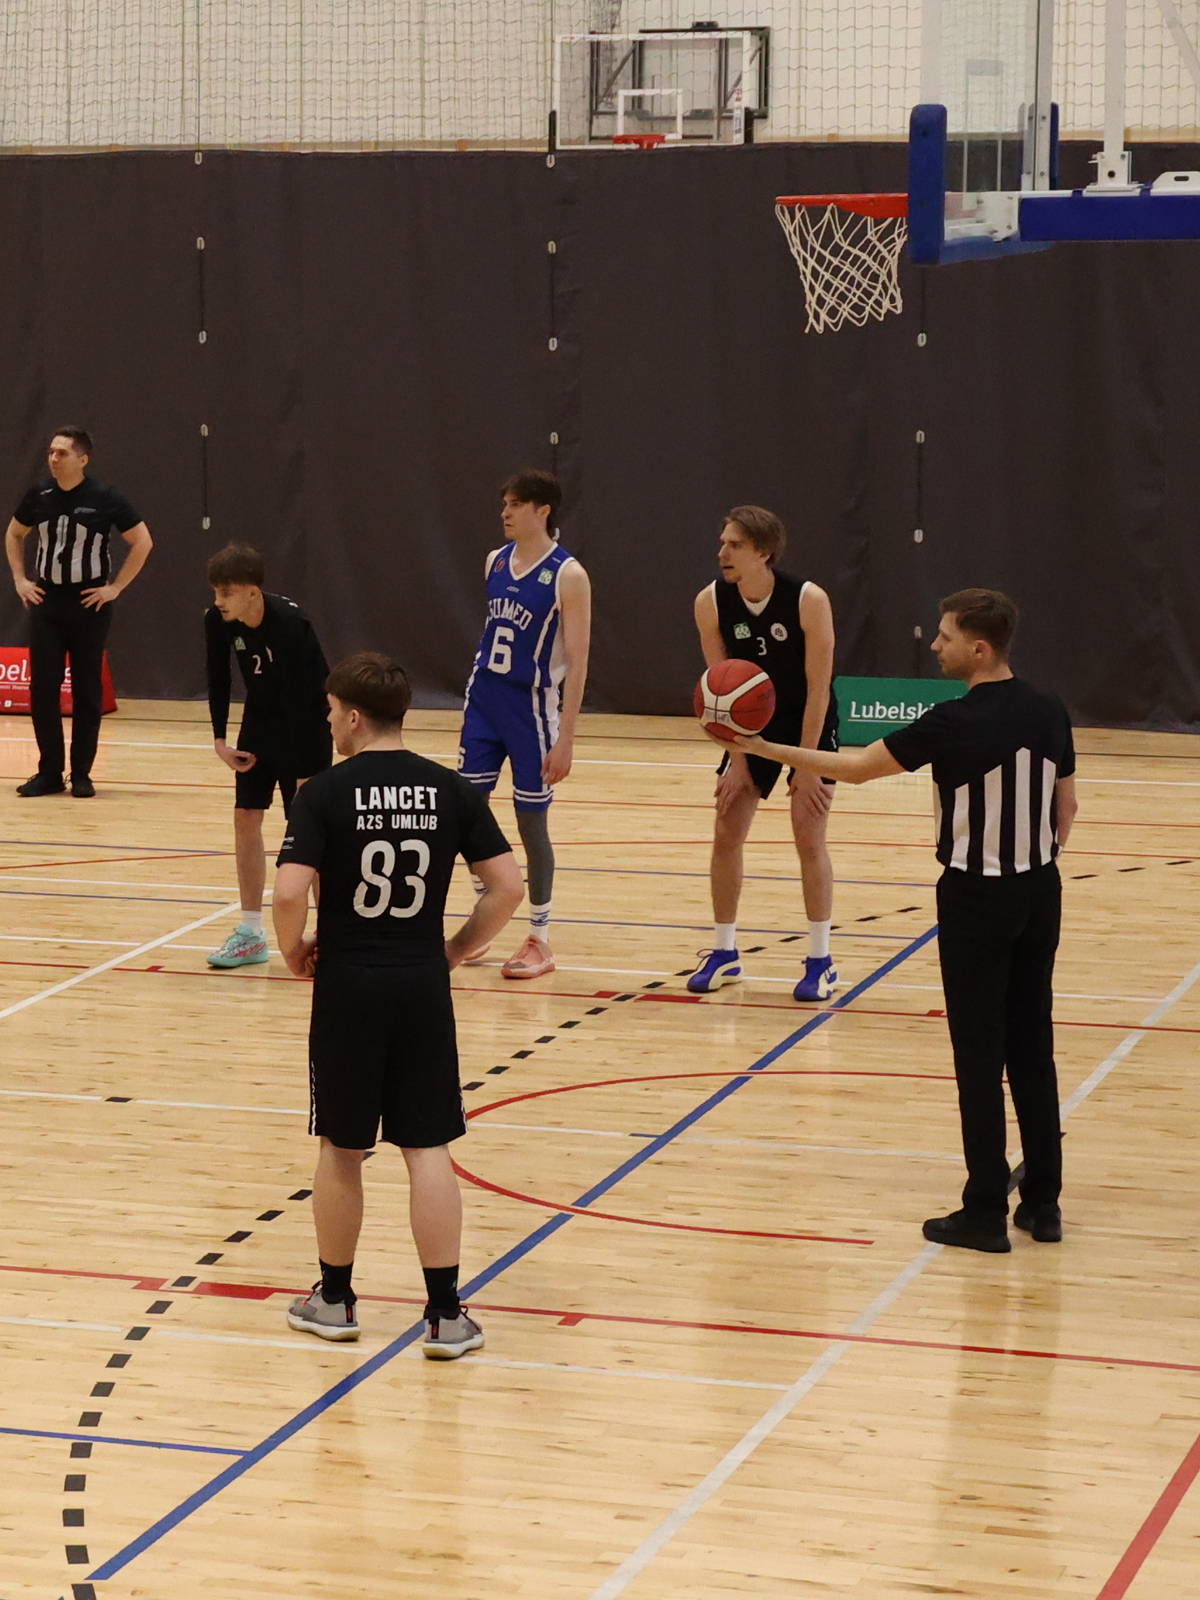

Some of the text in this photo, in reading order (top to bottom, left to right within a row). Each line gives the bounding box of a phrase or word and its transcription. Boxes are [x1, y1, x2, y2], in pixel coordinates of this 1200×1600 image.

[487, 626, 515, 674] 6
[756, 636, 768, 656] 3
[252, 654, 263, 675] 2
[355, 786, 438, 811] LANCET
[356, 814, 438, 831] AZS UMLUB
[353, 839, 430, 919] 83
